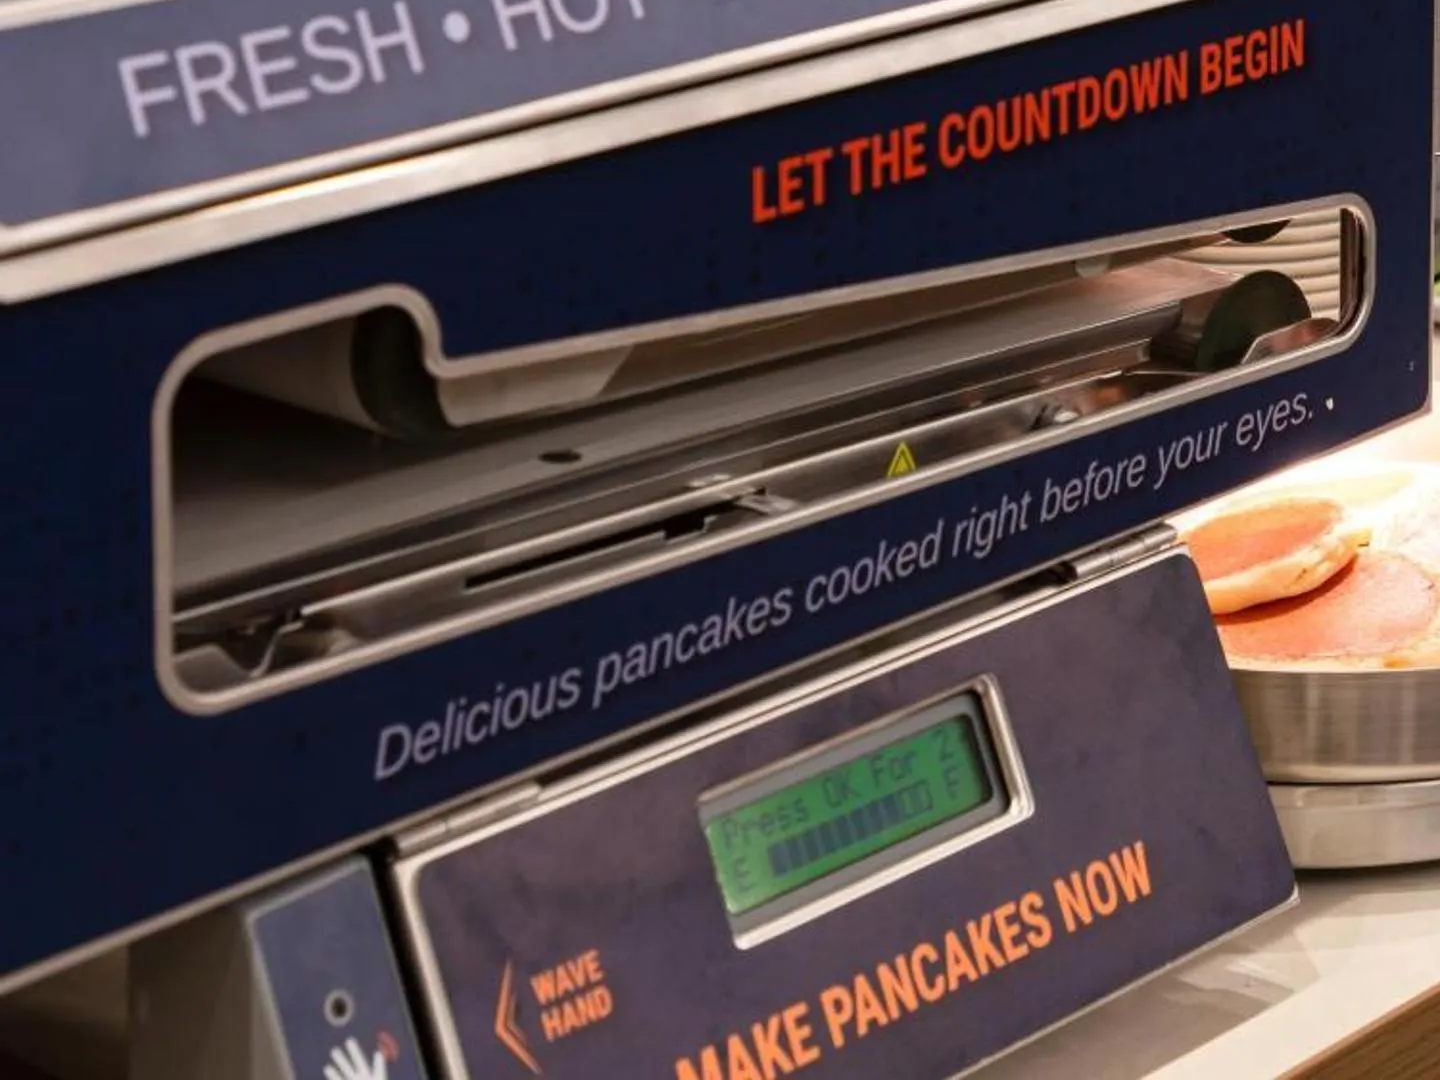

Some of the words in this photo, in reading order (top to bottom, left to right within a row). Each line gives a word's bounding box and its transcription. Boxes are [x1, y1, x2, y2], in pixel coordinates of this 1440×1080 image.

[118, 0, 425, 137] FRESH
[750, 148, 833, 223] LET
[841, 122, 928, 197] THE
[936, 50, 1190, 170] COUNTDOWN
[1200, 18, 1307, 96] BEGIN
[373, 667, 583, 781] Delicious
[590, 586, 795, 709] pancakes
[804, 518, 945, 613] cooked
[951, 489, 1034, 560] right
[1039, 453, 1147, 524] before
[1153, 421, 1229, 491] your
[1234, 391, 1314, 453] eyes.
[720, 798, 811, 849] Press
[822, 774, 857, 810] OK
[870, 749, 918, 789] For
[529, 949, 605, 1008] WAVE
[819, 890, 1054, 1049] PANCAKES
[1053, 840, 1152, 933] NOW
[540, 986, 614, 1042] HAND
